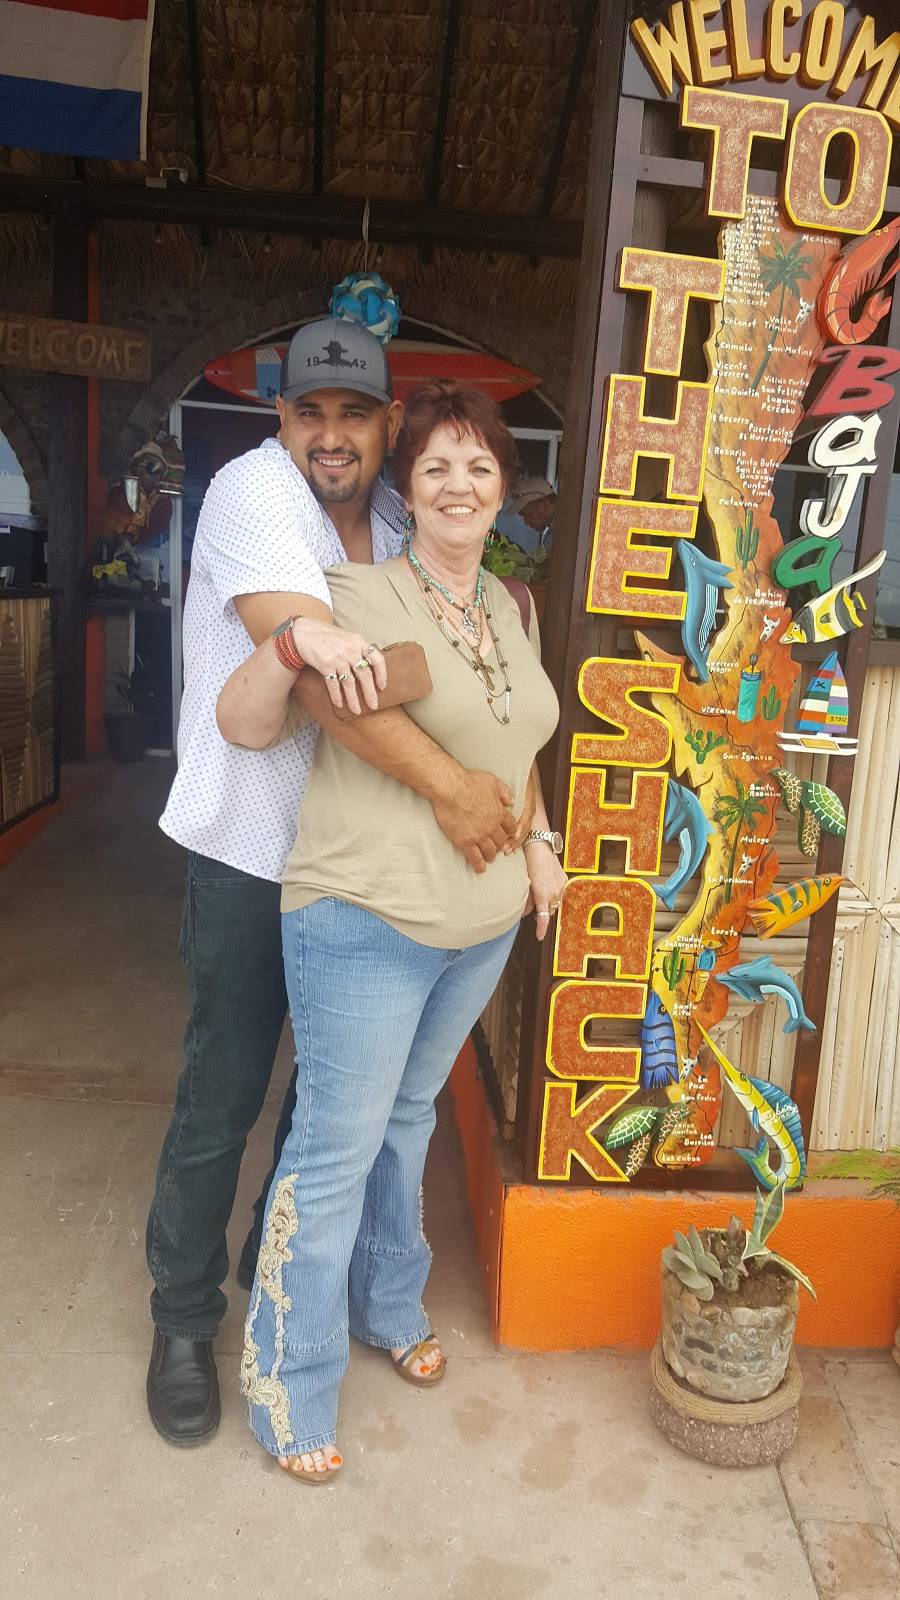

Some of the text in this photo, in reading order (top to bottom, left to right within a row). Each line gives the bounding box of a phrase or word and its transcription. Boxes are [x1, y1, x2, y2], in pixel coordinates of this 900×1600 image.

[630, 0, 900, 126] WELCOM
[682, 85, 893, 237] TO
[0, 321, 145, 375] ELCOME
[351, 358, 367, 370] 42
[587, 247, 726, 621] THE
[537, 656, 682, 1182] SHACK
